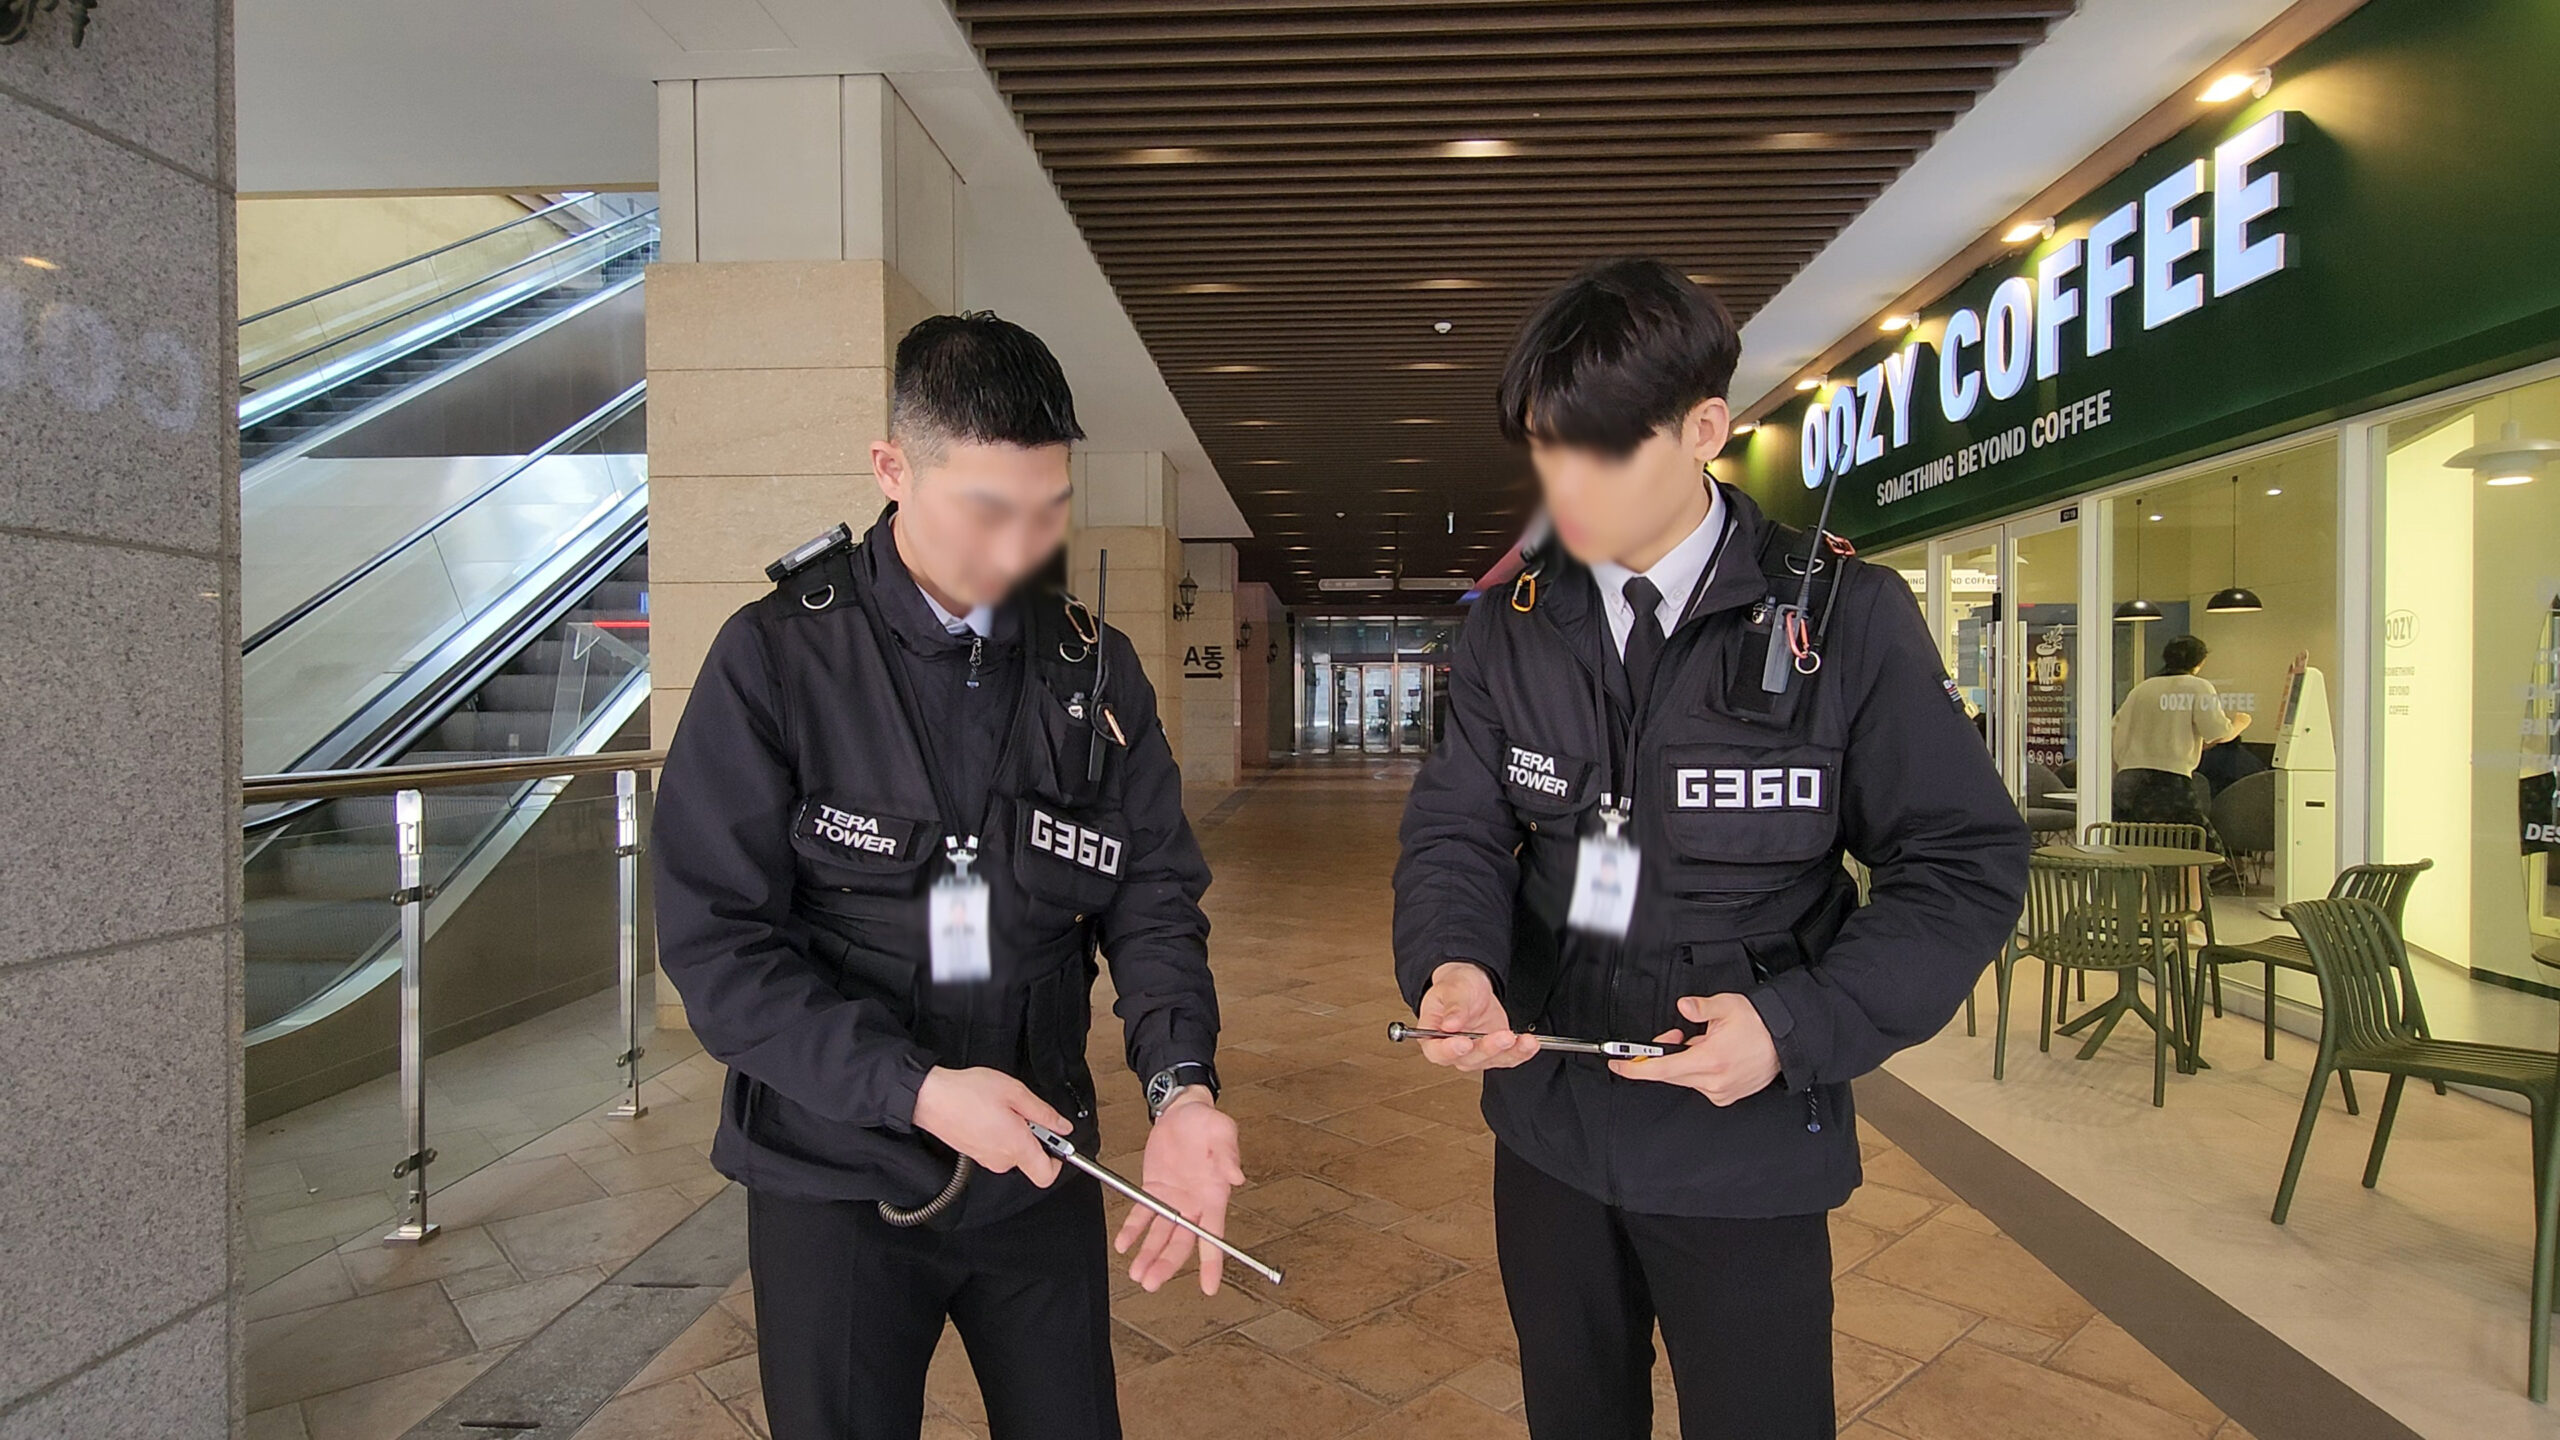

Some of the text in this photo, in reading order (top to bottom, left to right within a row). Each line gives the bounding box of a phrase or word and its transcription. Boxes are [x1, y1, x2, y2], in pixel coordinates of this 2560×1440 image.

[1801, 110, 2285, 489] OOZY COFFEE
[1876, 389, 2112, 507] SOMETHING BEYOND COFFEE
[2385, 616, 2413, 641] OOZY
[1183, 646, 1225, 670] A동
[2160, 693, 2195, 711] OOZY
[1511, 747, 1555, 775] TERA
[1507, 765, 1568, 797] TOWER
[1677, 768, 1821, 808] G360
[820, 804, 879, 834] TERA
[814, 818, 897, 855] TOWER
[1031, 809, 1122, 875] G360
